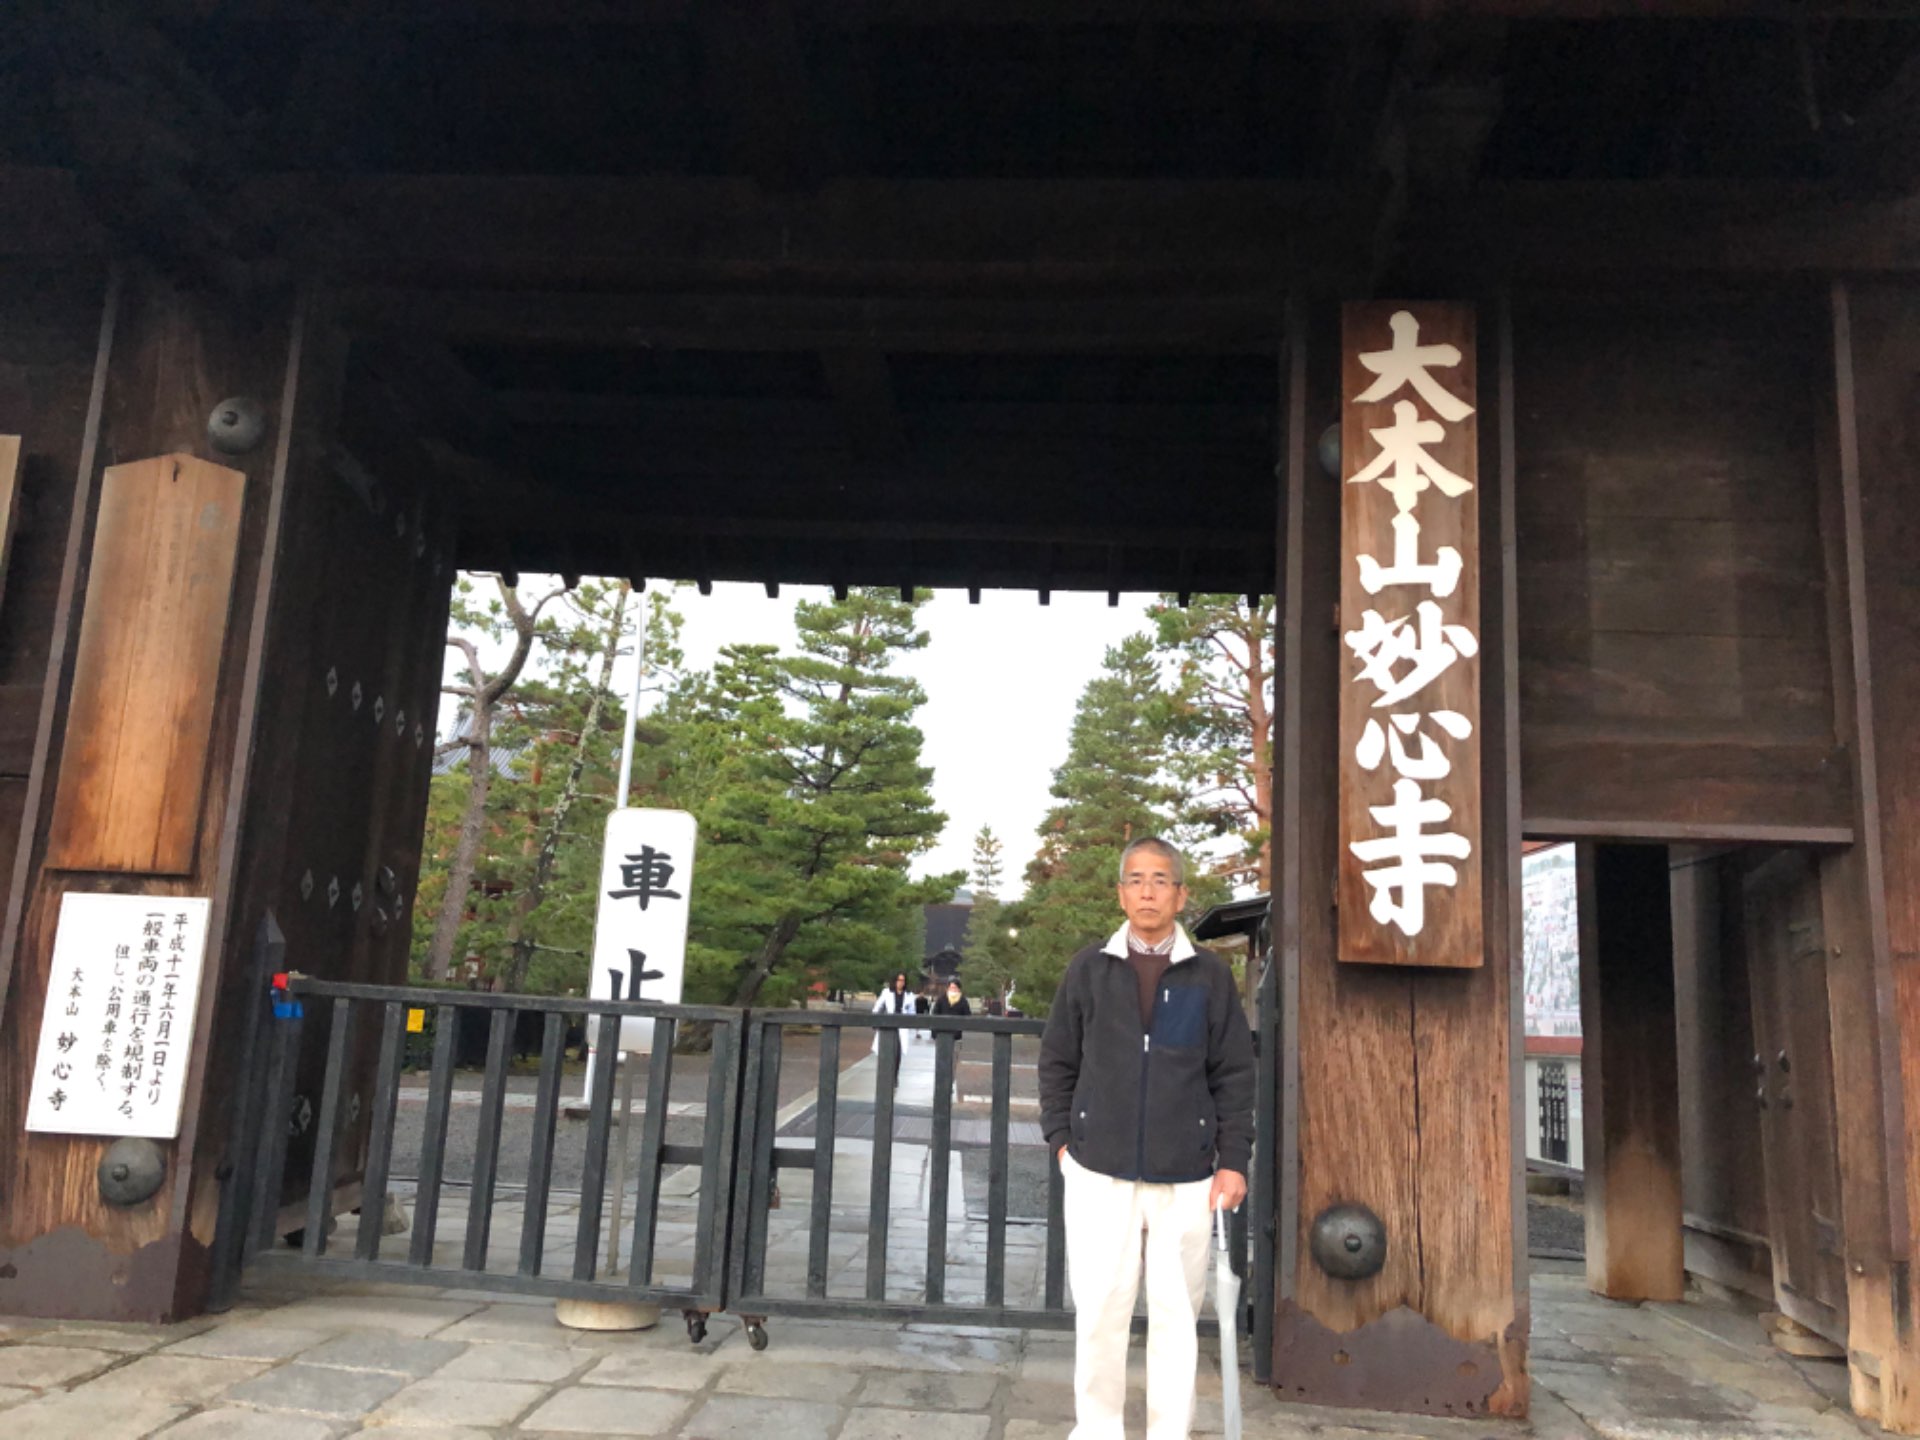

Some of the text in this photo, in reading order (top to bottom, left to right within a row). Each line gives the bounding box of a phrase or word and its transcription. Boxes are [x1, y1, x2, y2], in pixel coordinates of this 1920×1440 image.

[1344, 310, 1478, 936] 大本山妙心寺
[148, 913, 188, 1105] 平成十一年六月一日より
